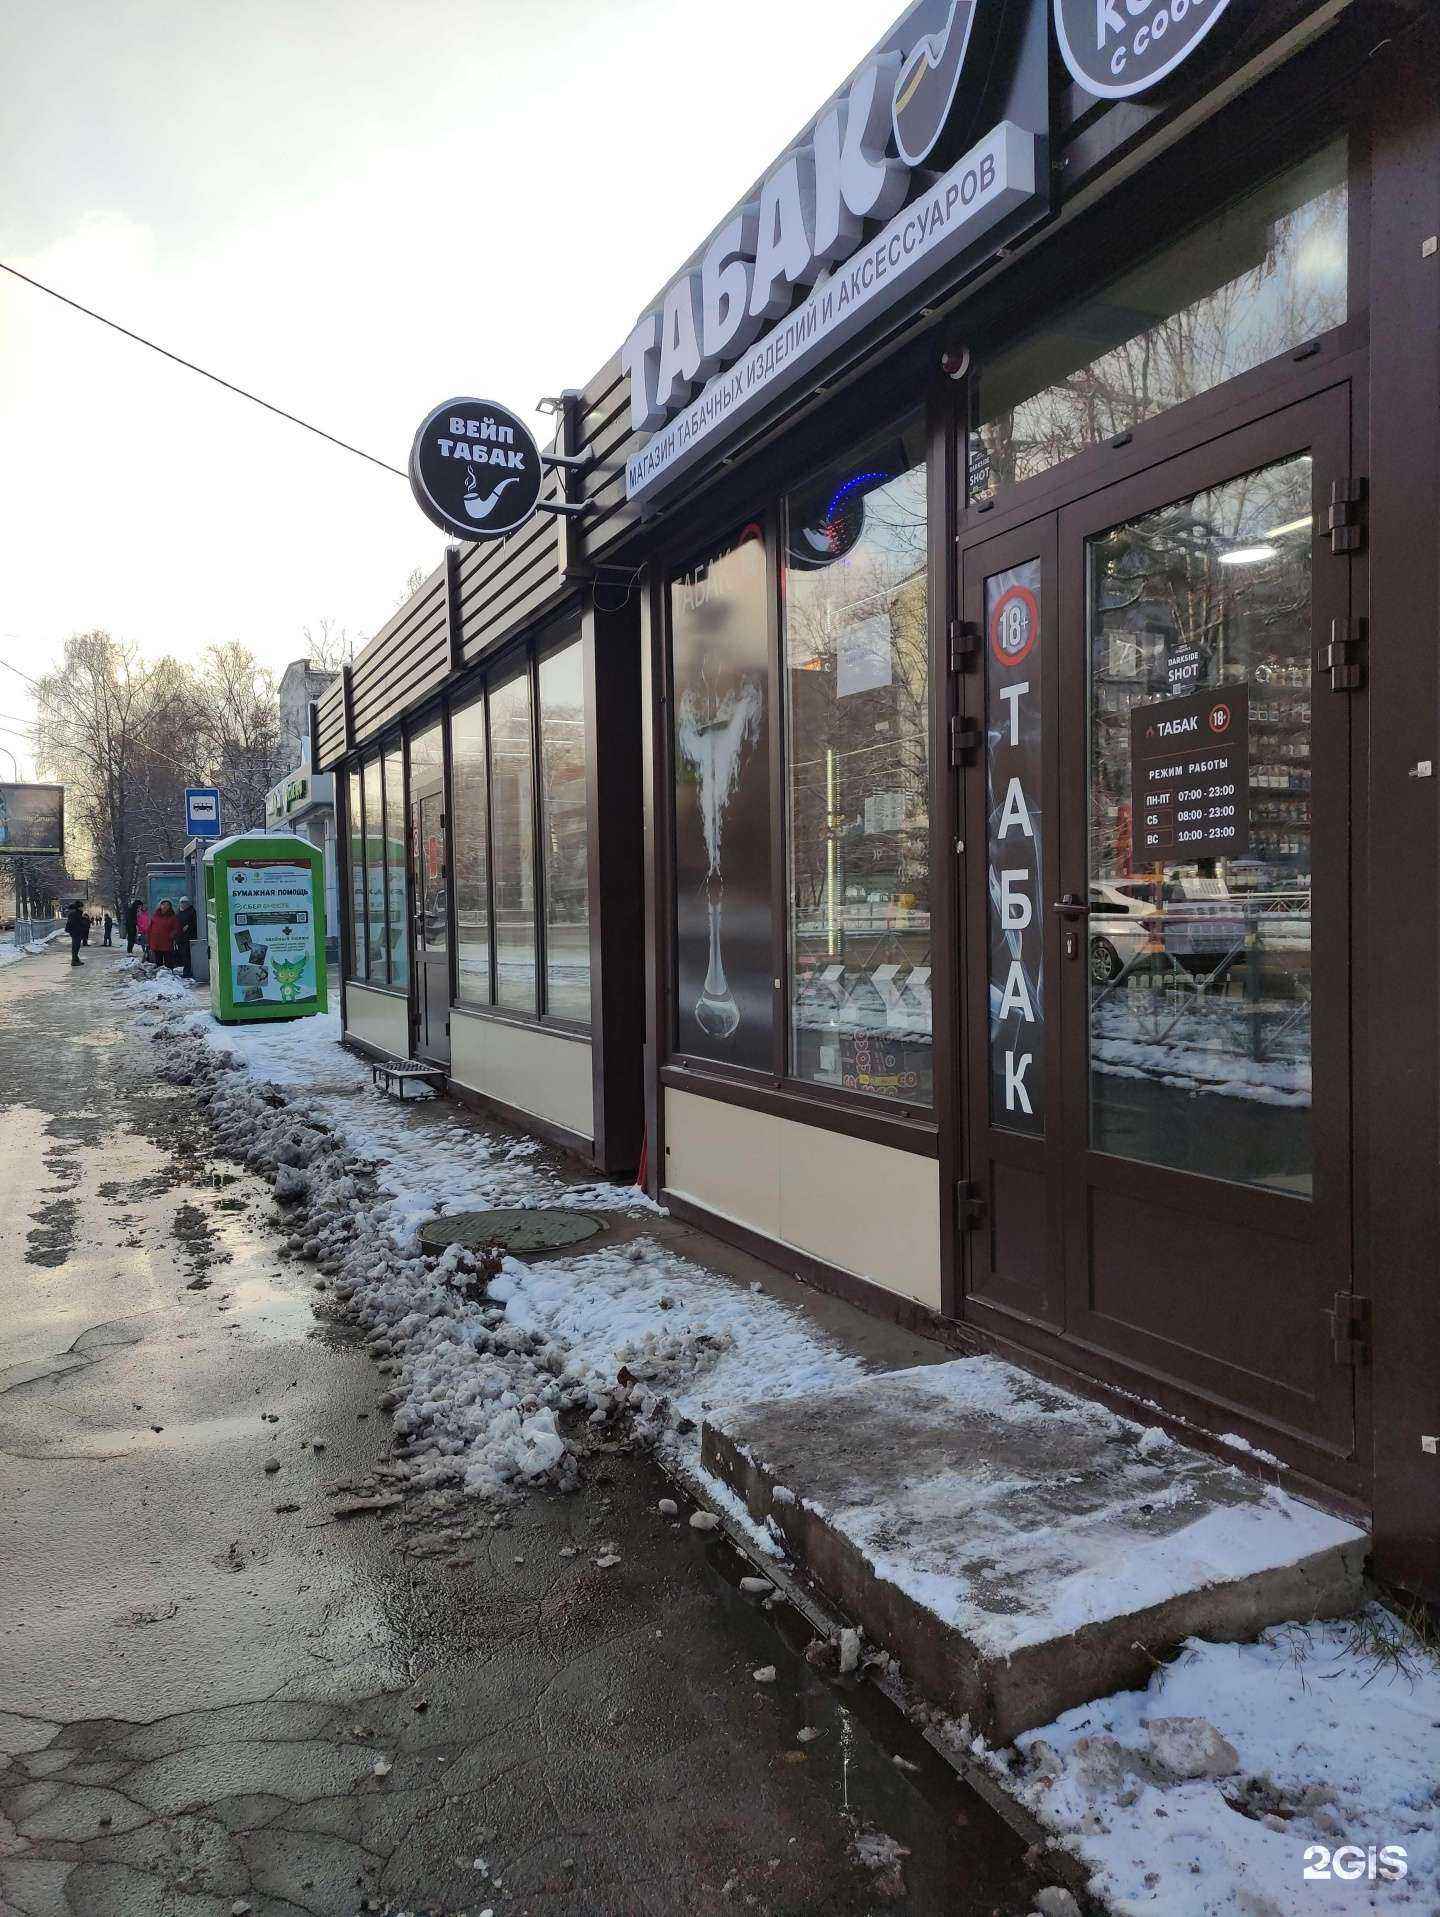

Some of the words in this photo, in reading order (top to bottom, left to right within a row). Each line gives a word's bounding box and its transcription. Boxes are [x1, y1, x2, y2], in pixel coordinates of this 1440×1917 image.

[622, 62, 888, 432] ТАБАК
[629, 432, 675, 490] МАГАЗИН
[677, 370, 743, 447] ТАБАЧНЫХ
[747, 298, 817, 388] ИЗДЕЛИЙ
[822, 292, 833, 324] И
[837, 153, 996, 311] АКСЕССУАРОВ
[449, 416, 514, 444] ВЕЙП
[437, 438, 525, 470] ТАБАК
[969, 466, 990, 486] SHOT
[1000, 606, 1029, 649] 18+
[1167, 651, 1199, 667] DARKSIDE
[1168, 664, 1199, 682] SHOT
[1157, 715, 1198, 737] ТАБАК
[1149, 765, 1183, 780] РЕЖИМ
[1189, 758, 1228, 774] РАБОТЫ
[1146, 793, 1170, 806] ПН-ПТ
[1178, 789, 1202, 802] 07:00
[1208, 784, 1235, 798] 23:00
[1147, 814, 1159, 825] СБ
[1177, 809, 1203, 822] 08:00
[1208, 805, 1235, 818] 23:00
[1147, 834, 1159, 845] ВС
[1178, 829, 1203, 842] 10:00
[1208, 826, 1235, 839] 23:00
[232, 889, 275, 897] БУМАЖНАЯ
[277, 888, 309, 897] ПОМОЩЬ
[997, 681, 1035, 1115] ТАБАК
